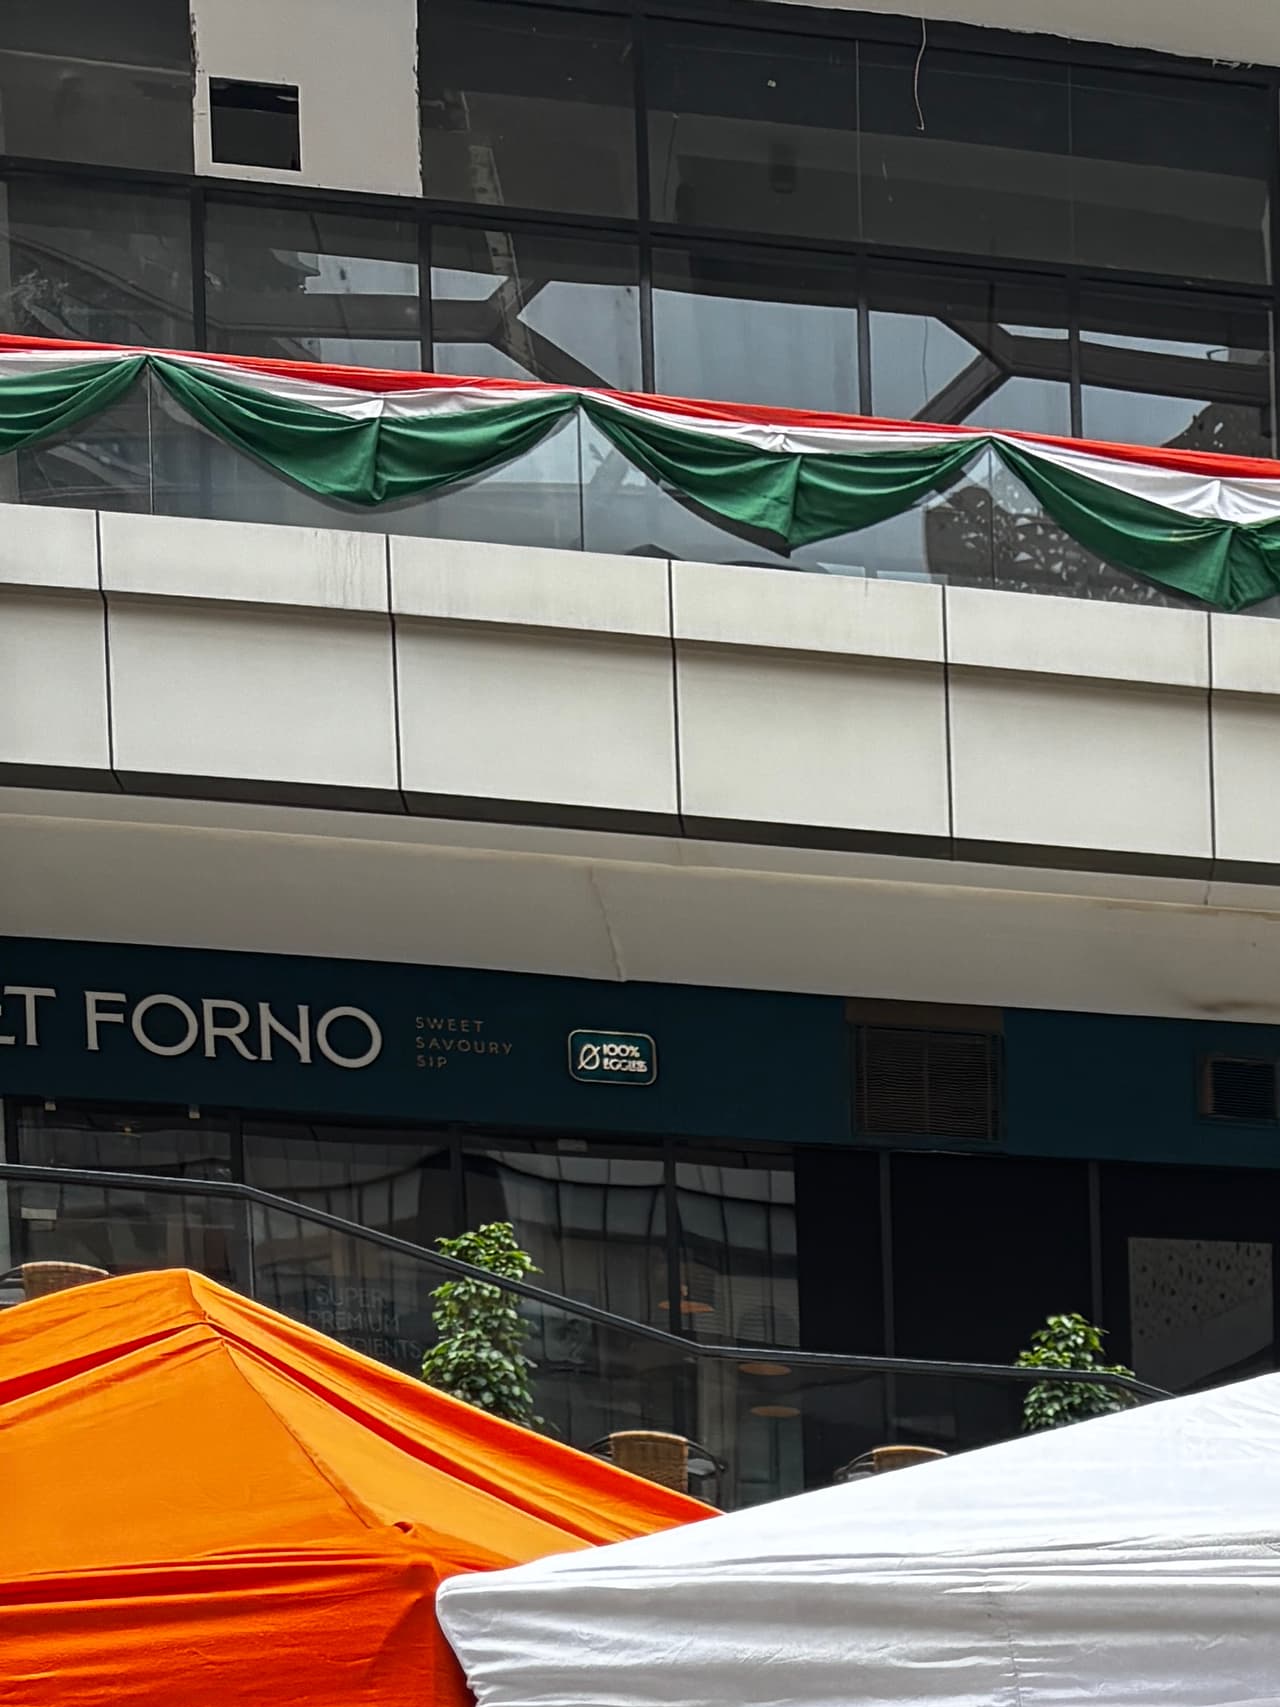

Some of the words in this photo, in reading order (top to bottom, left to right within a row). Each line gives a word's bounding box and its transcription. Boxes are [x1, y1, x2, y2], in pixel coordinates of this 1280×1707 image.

[84, 990, 383, 1069] FORNO
[415, 1016, 484, 1033] SWEET
[415, 1037, 513, 1055] SAVOURY
[602, 1043, 641, 1058] 100%
[416, 1055, 448, 1068] SIP
[315, 1286, 386, 1309] SUPER
[307, 1309, 400, 1335] PREMIUM
